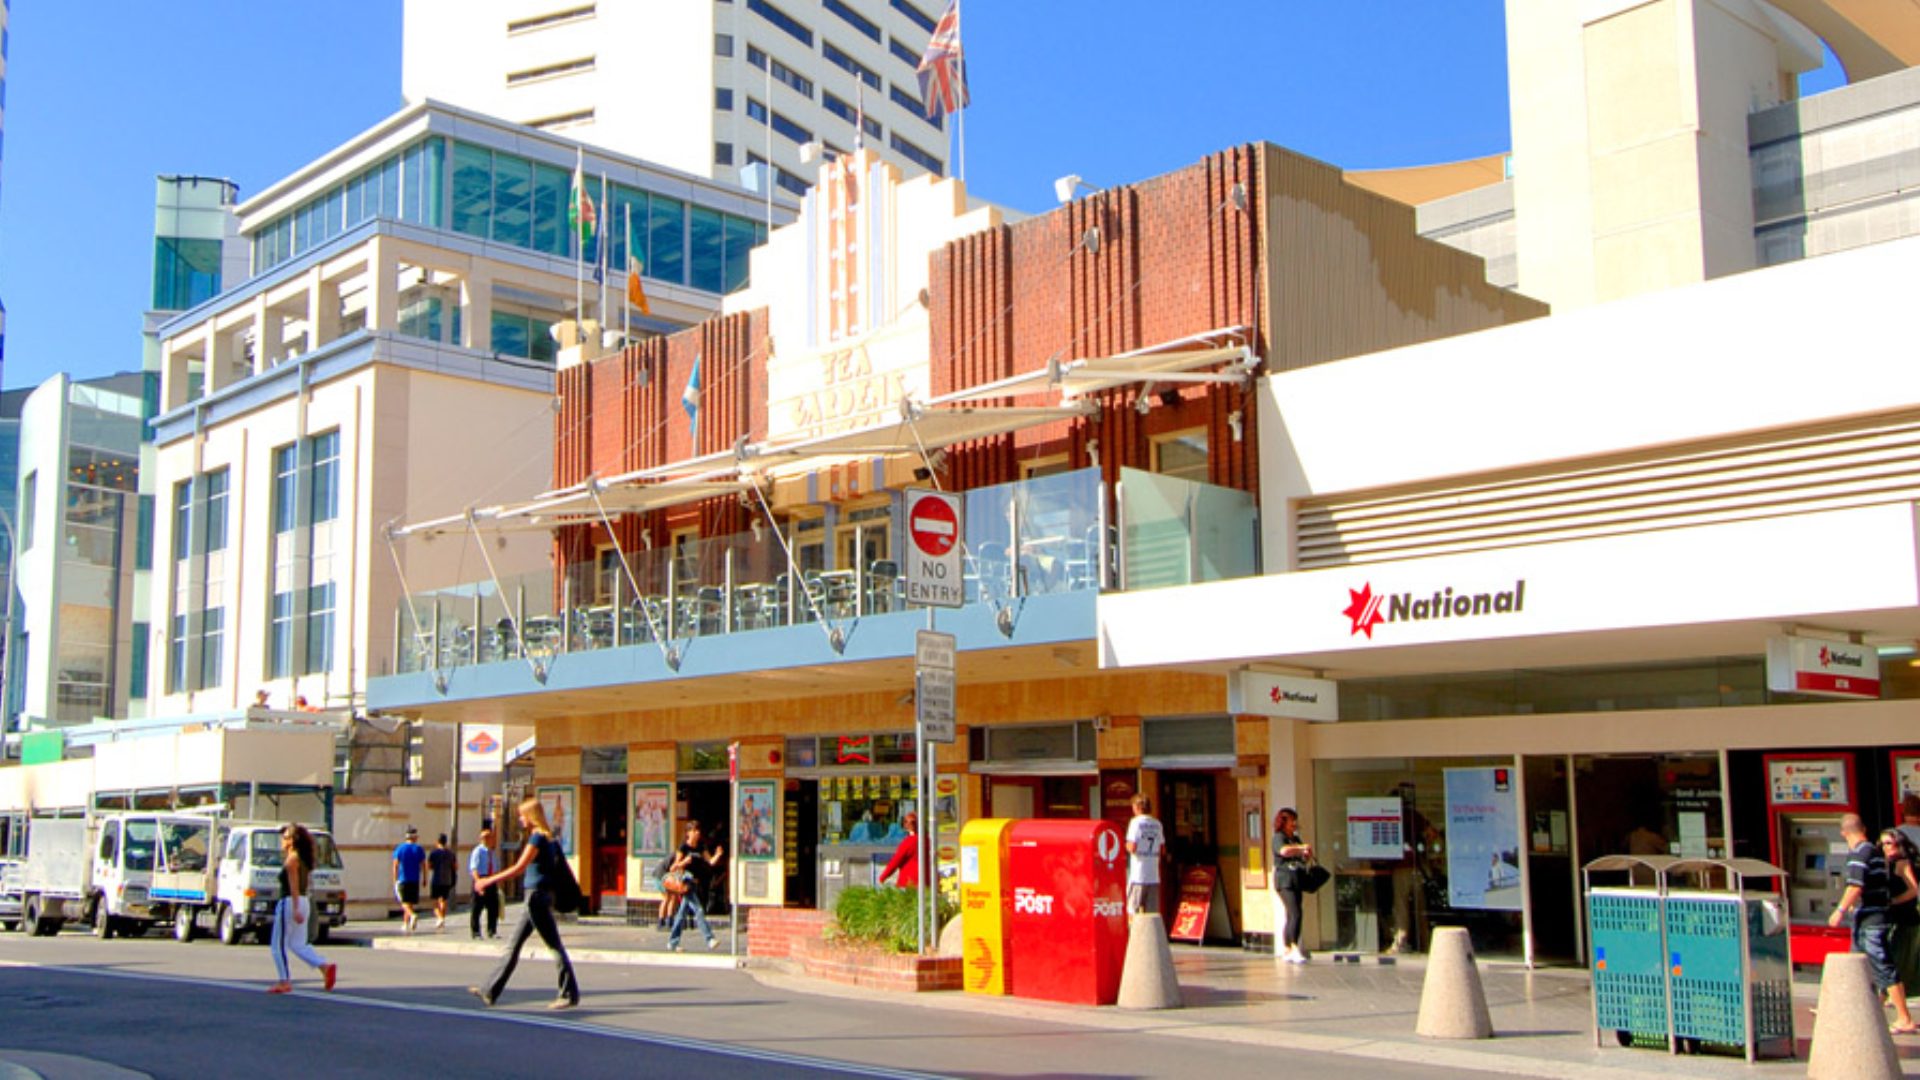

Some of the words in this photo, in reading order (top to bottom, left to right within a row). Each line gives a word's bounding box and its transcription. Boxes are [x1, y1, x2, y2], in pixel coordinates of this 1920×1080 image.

[819, 344, 872, 385] TEA
[922, 561, 947, 579] NO
[911, 583, 960, 602] ENTRY
[1388, 580, 1525, 623] National
[1014, 894, 1054, 915] POST
[1092, 901, 1123, 917] POST
